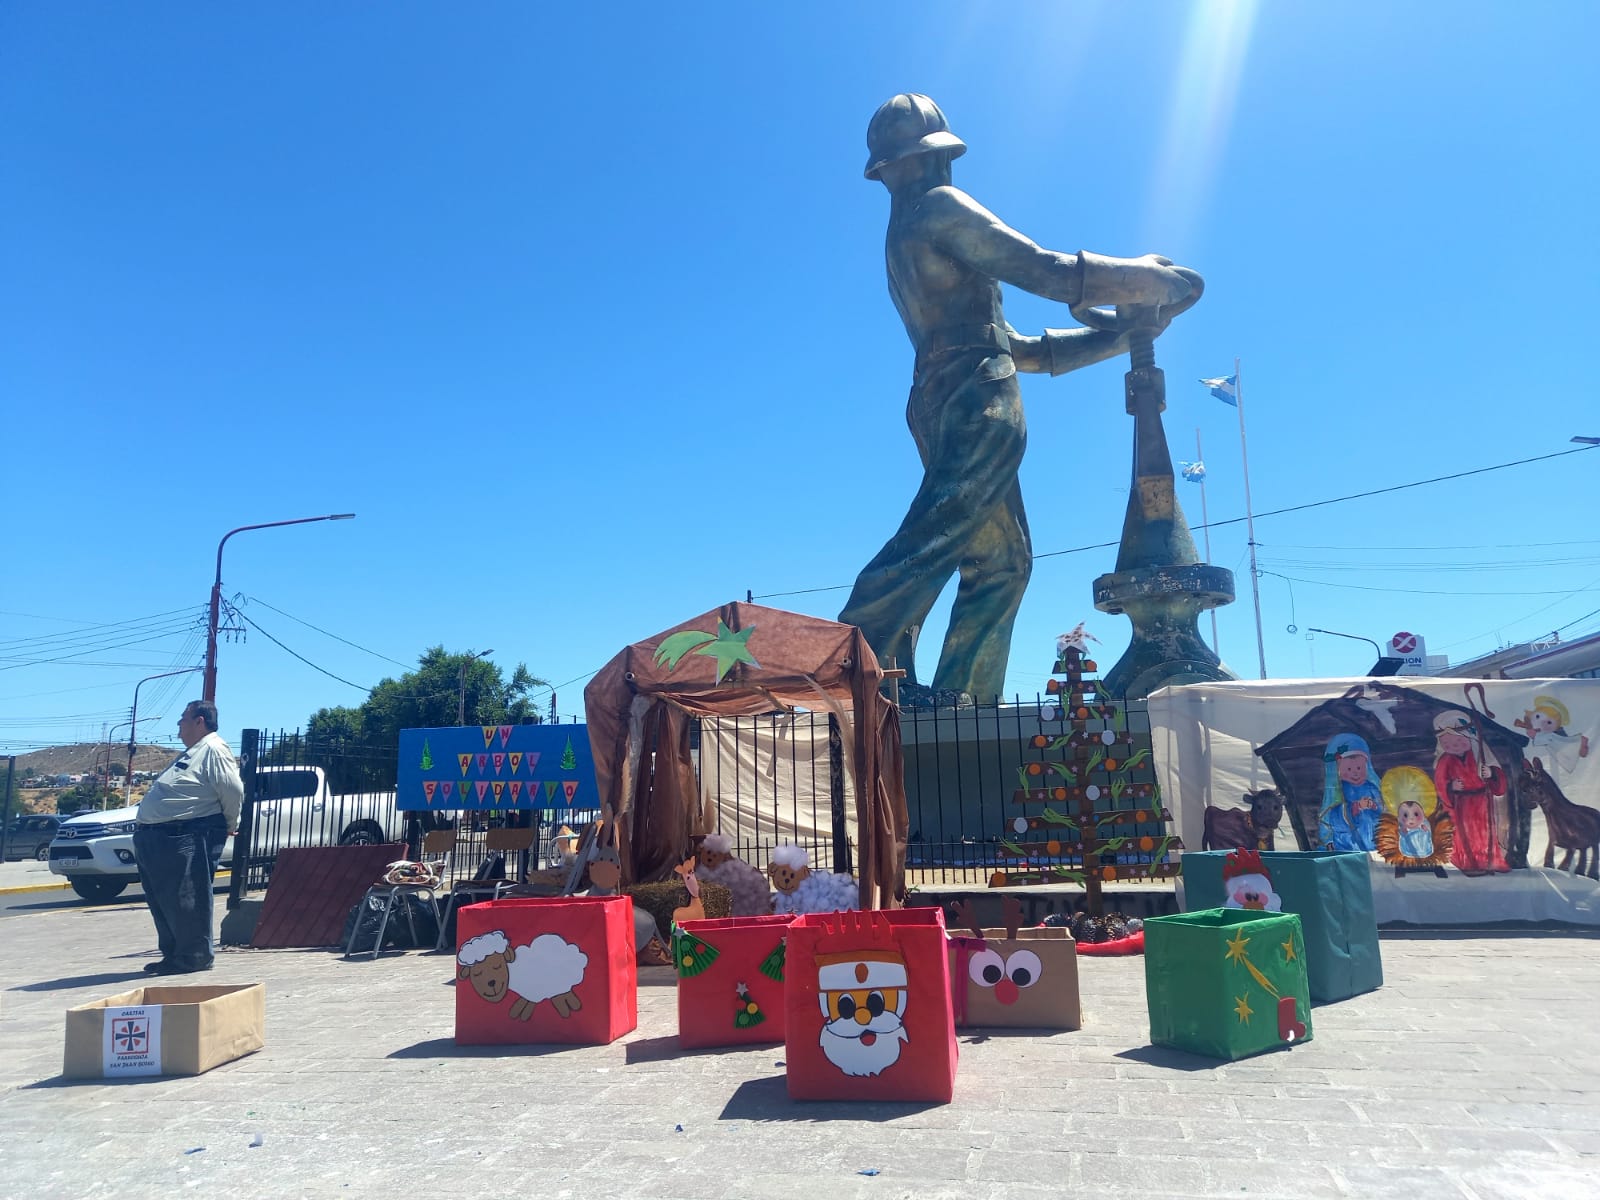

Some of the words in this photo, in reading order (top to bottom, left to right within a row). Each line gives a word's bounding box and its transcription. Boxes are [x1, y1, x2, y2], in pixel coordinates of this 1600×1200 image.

[485, 728, 509, 740] UN
[461, 754, 536, 768] ARBOL
[426, 783, 573, 797] SOLIDARIO
